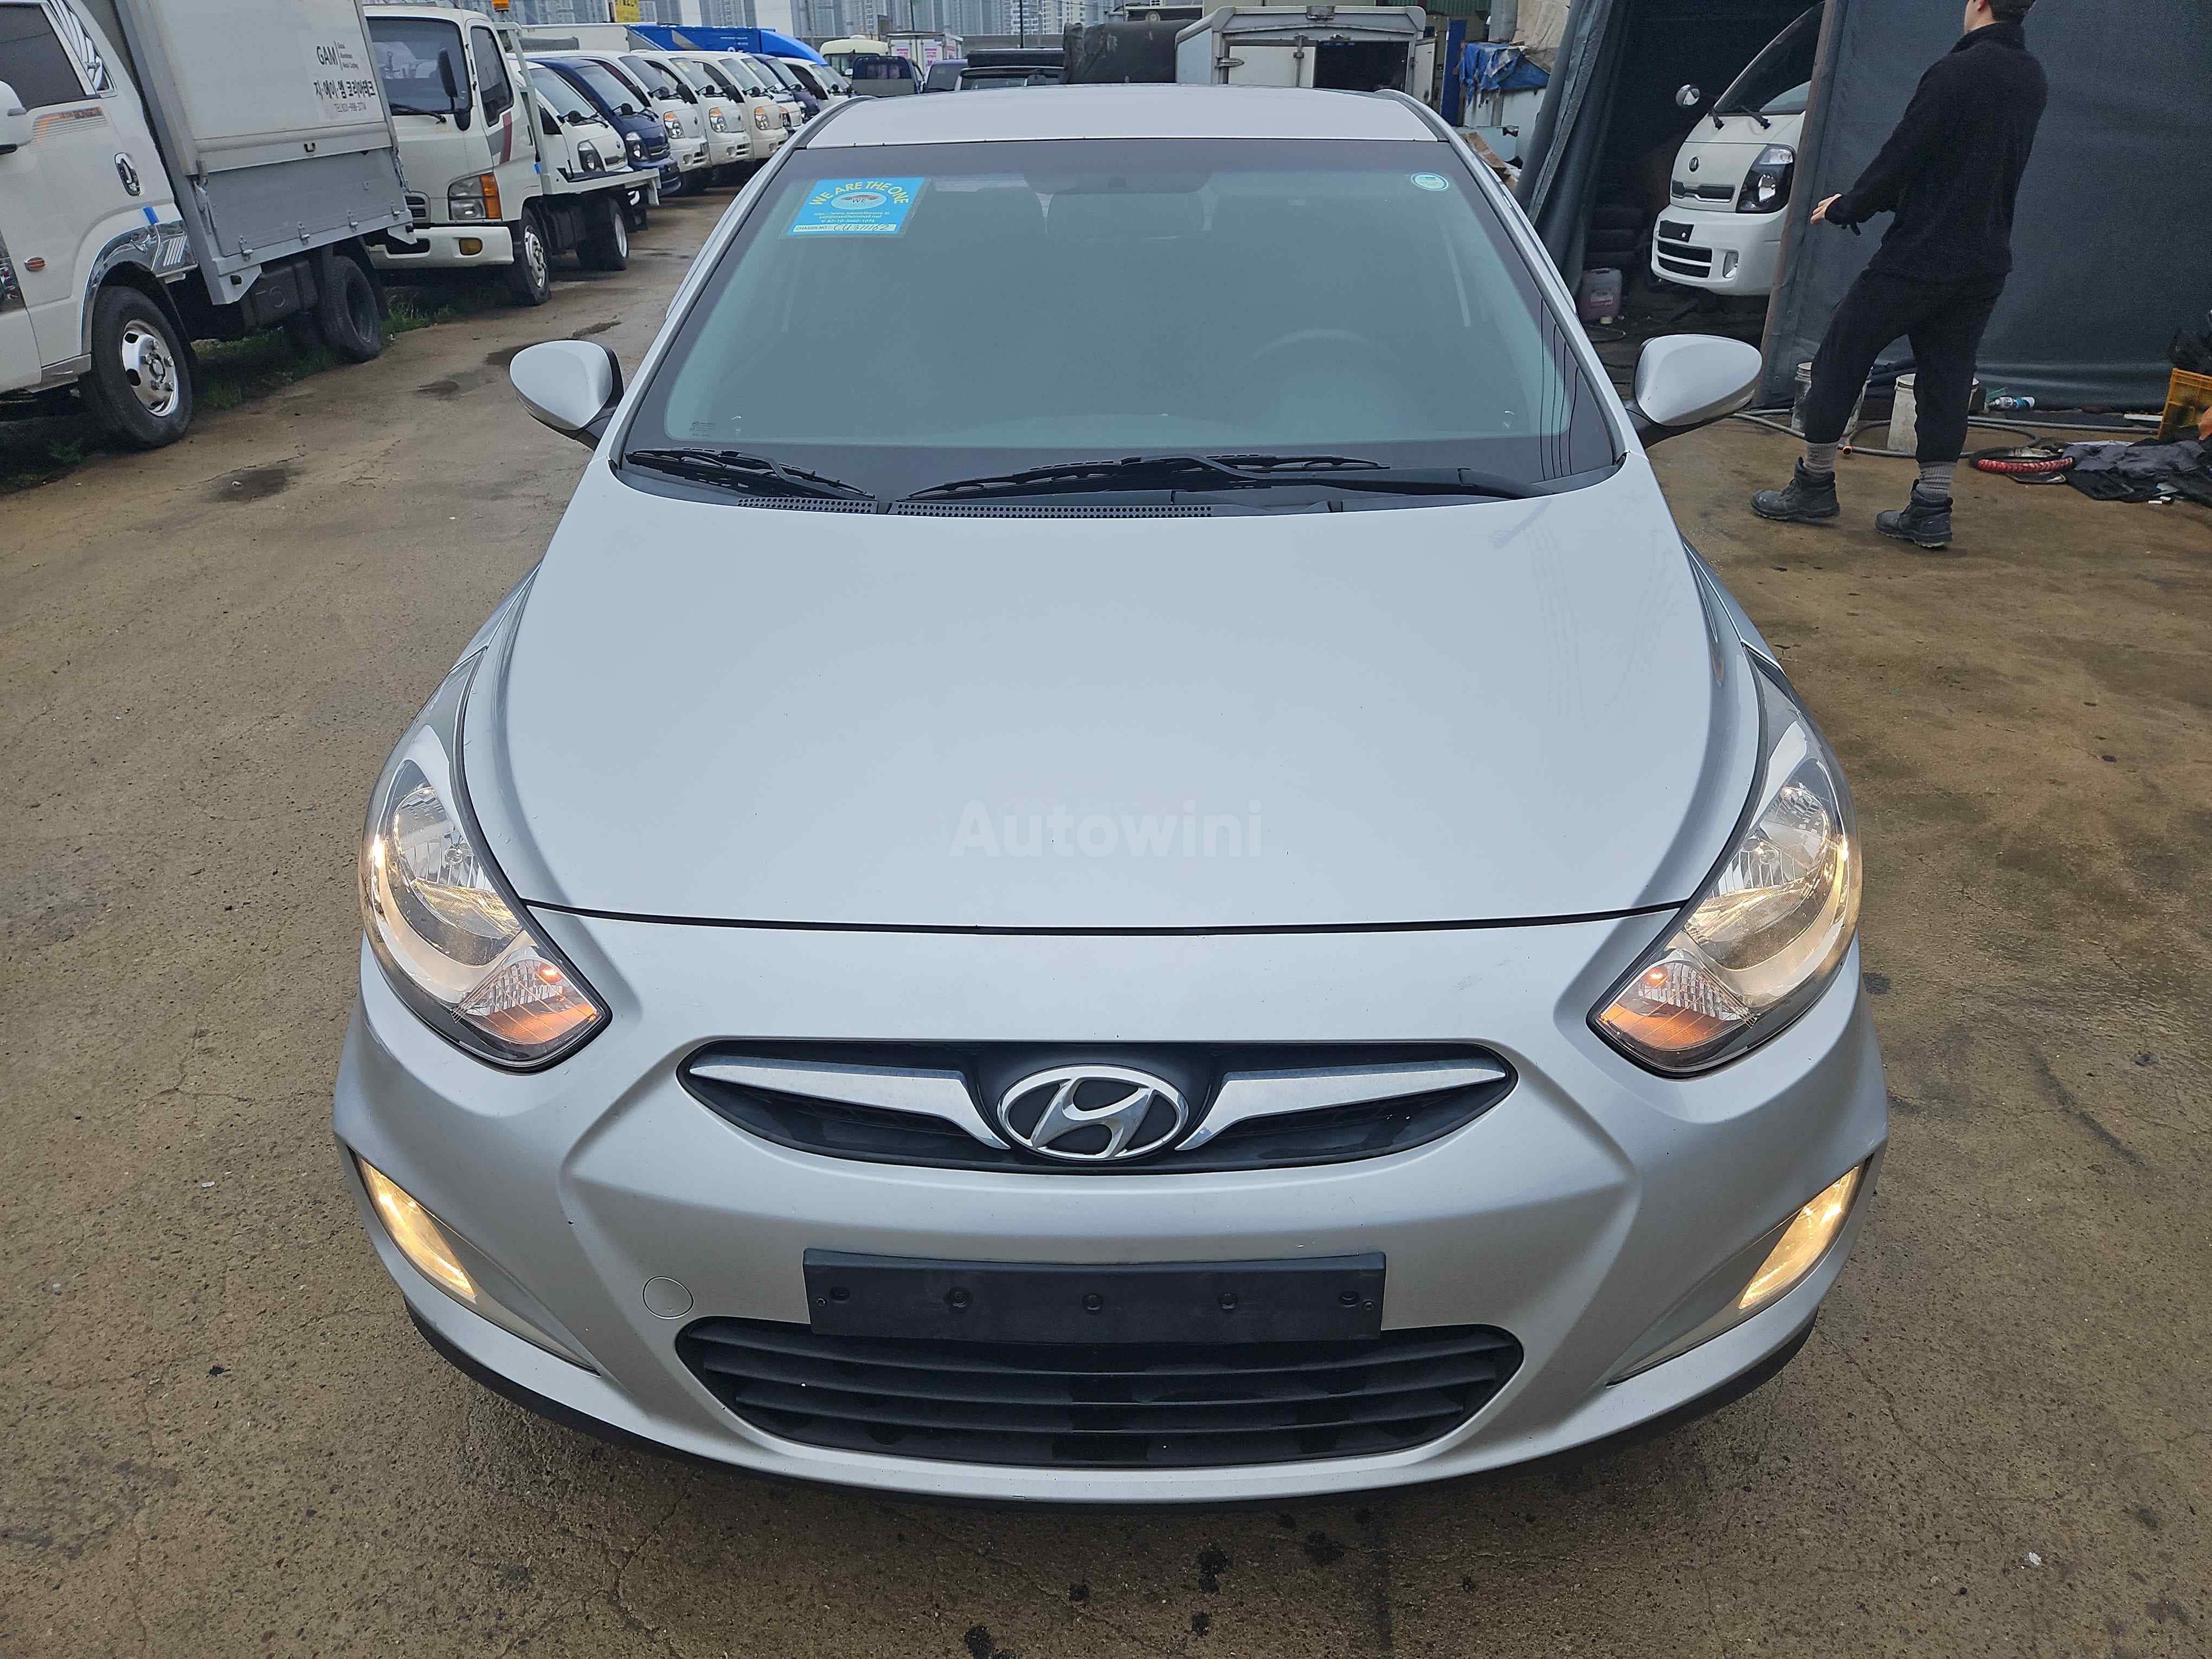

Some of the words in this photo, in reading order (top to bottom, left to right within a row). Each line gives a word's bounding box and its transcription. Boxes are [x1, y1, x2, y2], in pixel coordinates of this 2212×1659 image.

[317, 46, 338, 66] GAM
[809, 191, 833, 205] WE
[835, 182, 864, 195] ARE
[865, 181, 892, 191] THE
[888, 187, 910, 204] ONE
